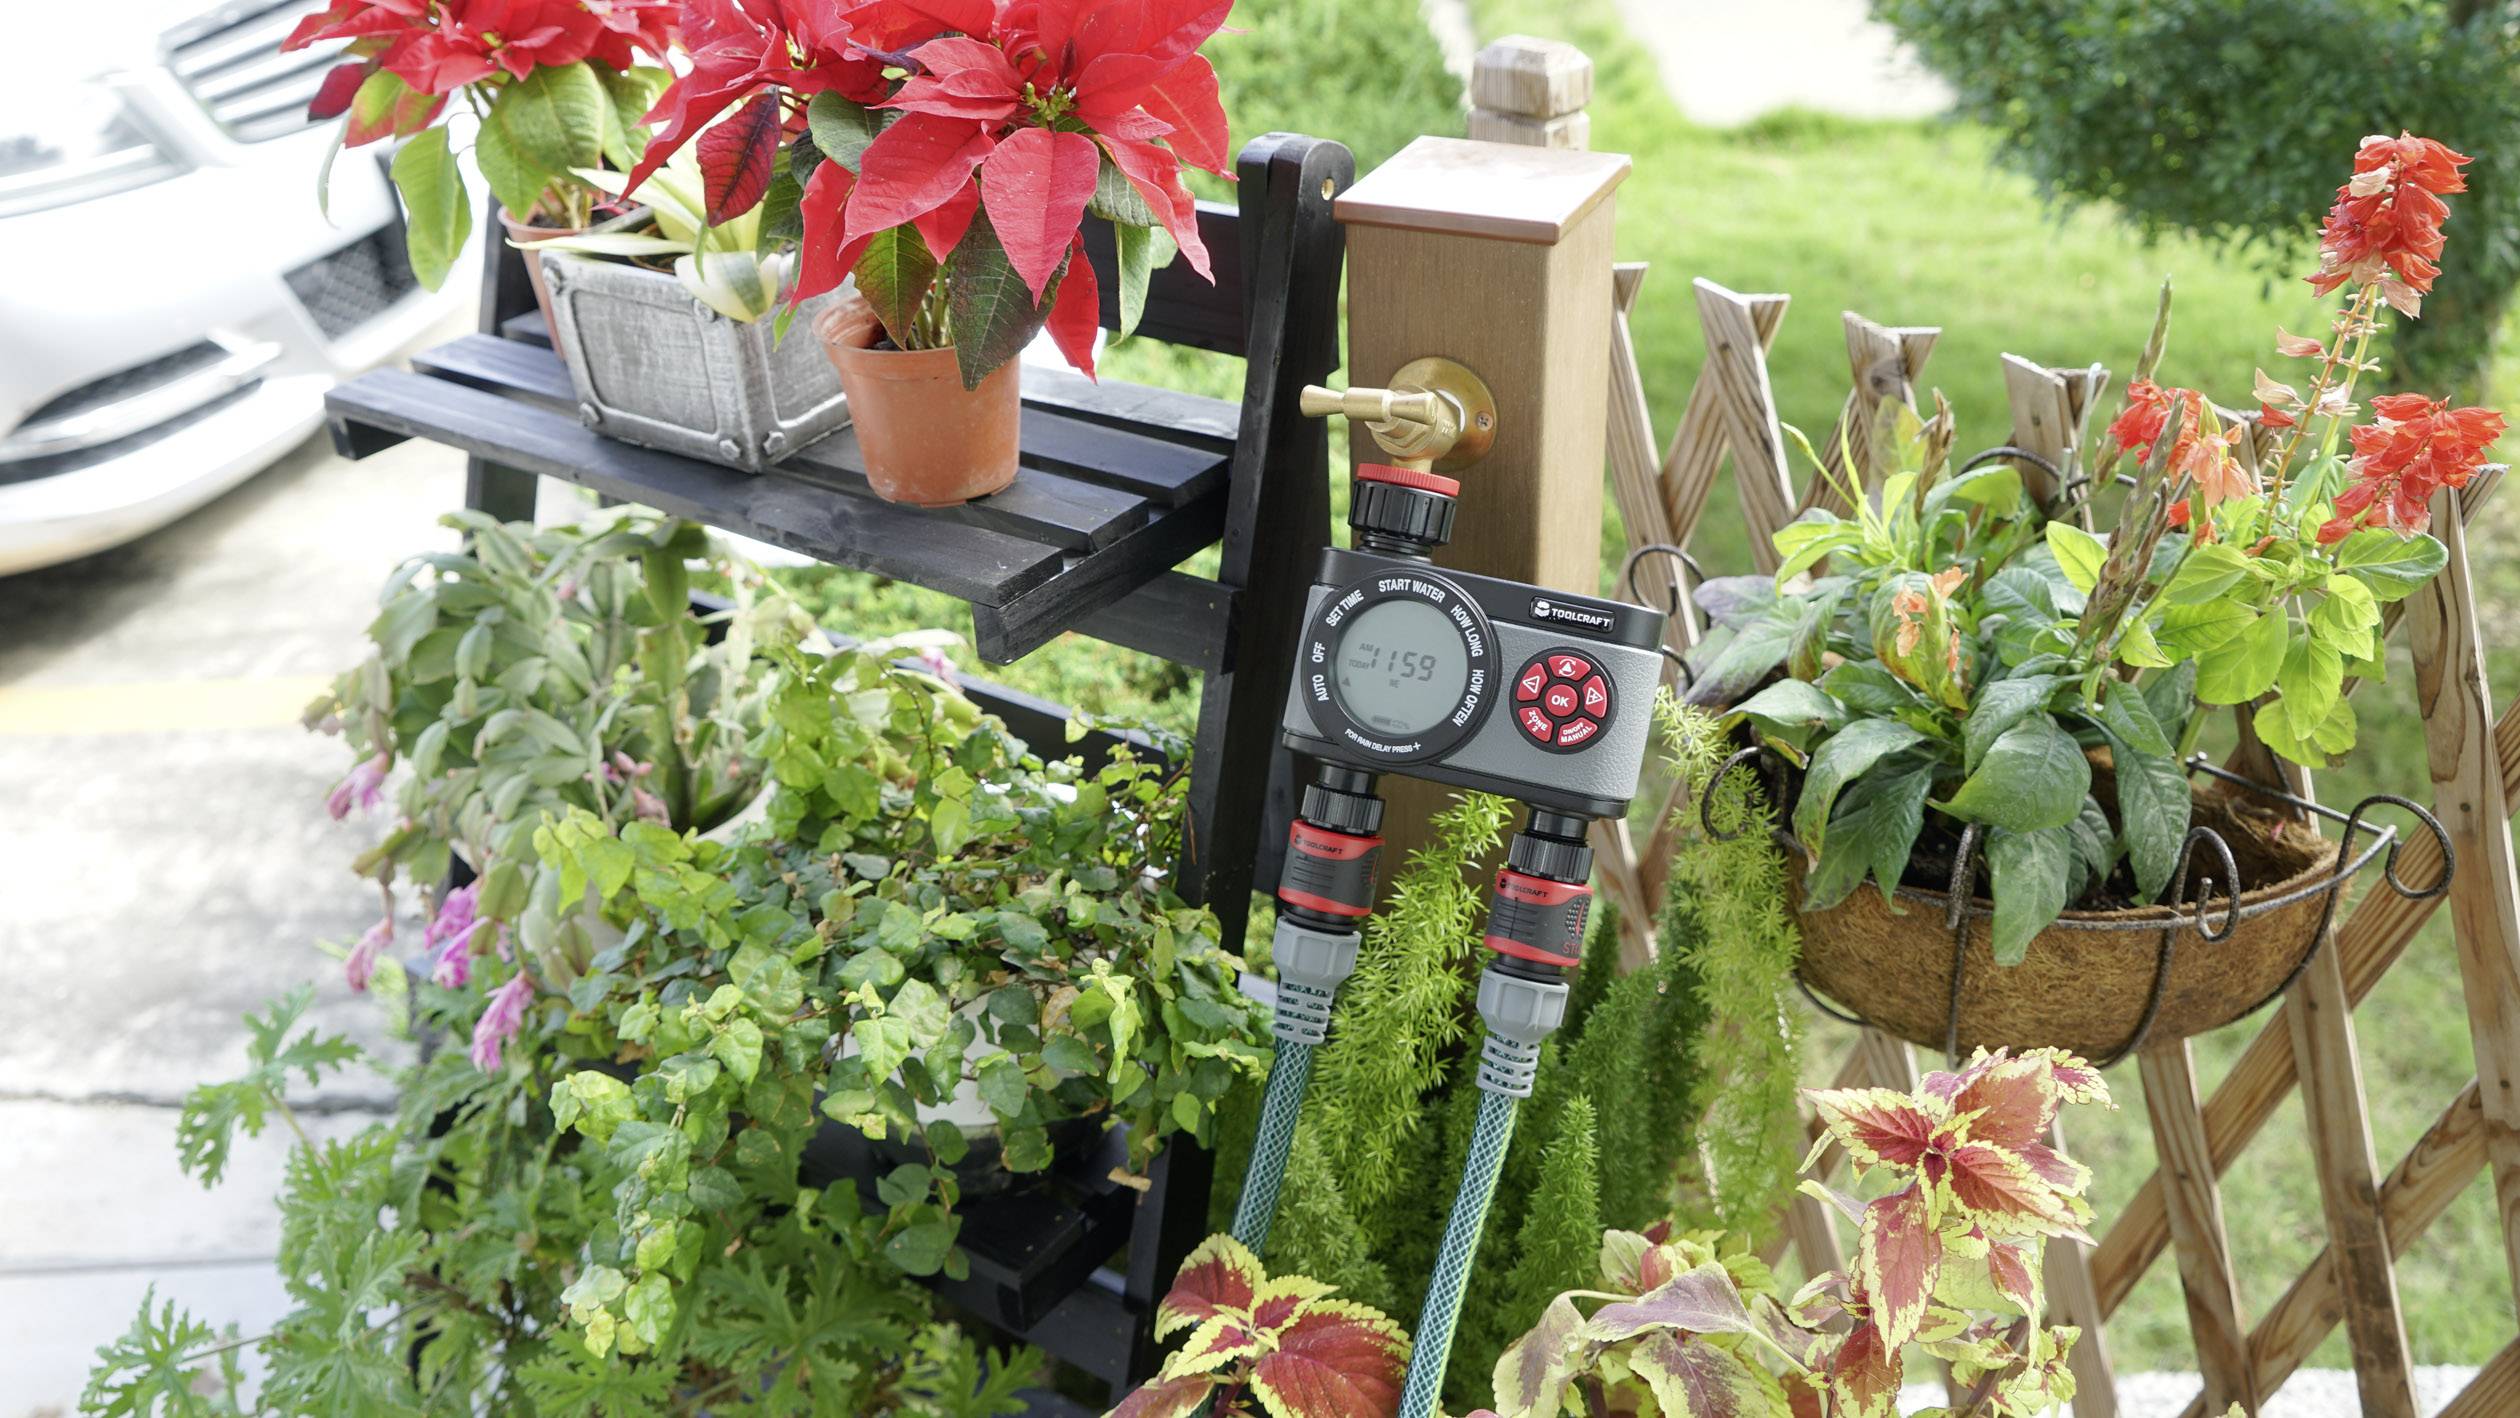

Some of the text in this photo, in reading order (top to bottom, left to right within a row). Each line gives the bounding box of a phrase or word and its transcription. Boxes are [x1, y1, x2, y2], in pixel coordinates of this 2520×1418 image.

[1378, 579, 1446, 603] START WATER
[1325, 589, 1364, 627] SET TIME
[1551, 608, 1610, 627] TOOLCRAFT
[1450, 604, 1484, 657] HOW LONG
[1312, 642, 1326, 663] OFF
[1312, 674, 1329, 702] AUTO
[1452, 669, 1484, 727] HOW OFTEN
[1551, 695, 1570, 707] OK
[1528, 710, 1548, 731] ZONE
[1562, 722, 1584, 735] ON/OFF
[1344, 728, 1358, 741] FOR
[1356, 736, 1372, 748] RAIN
[1371, 742, 1392, 752] DELAY
[1560, 726, 1593, 743] MANUAL
[1303, 840, 1343, 855] TOOLCRAFT
